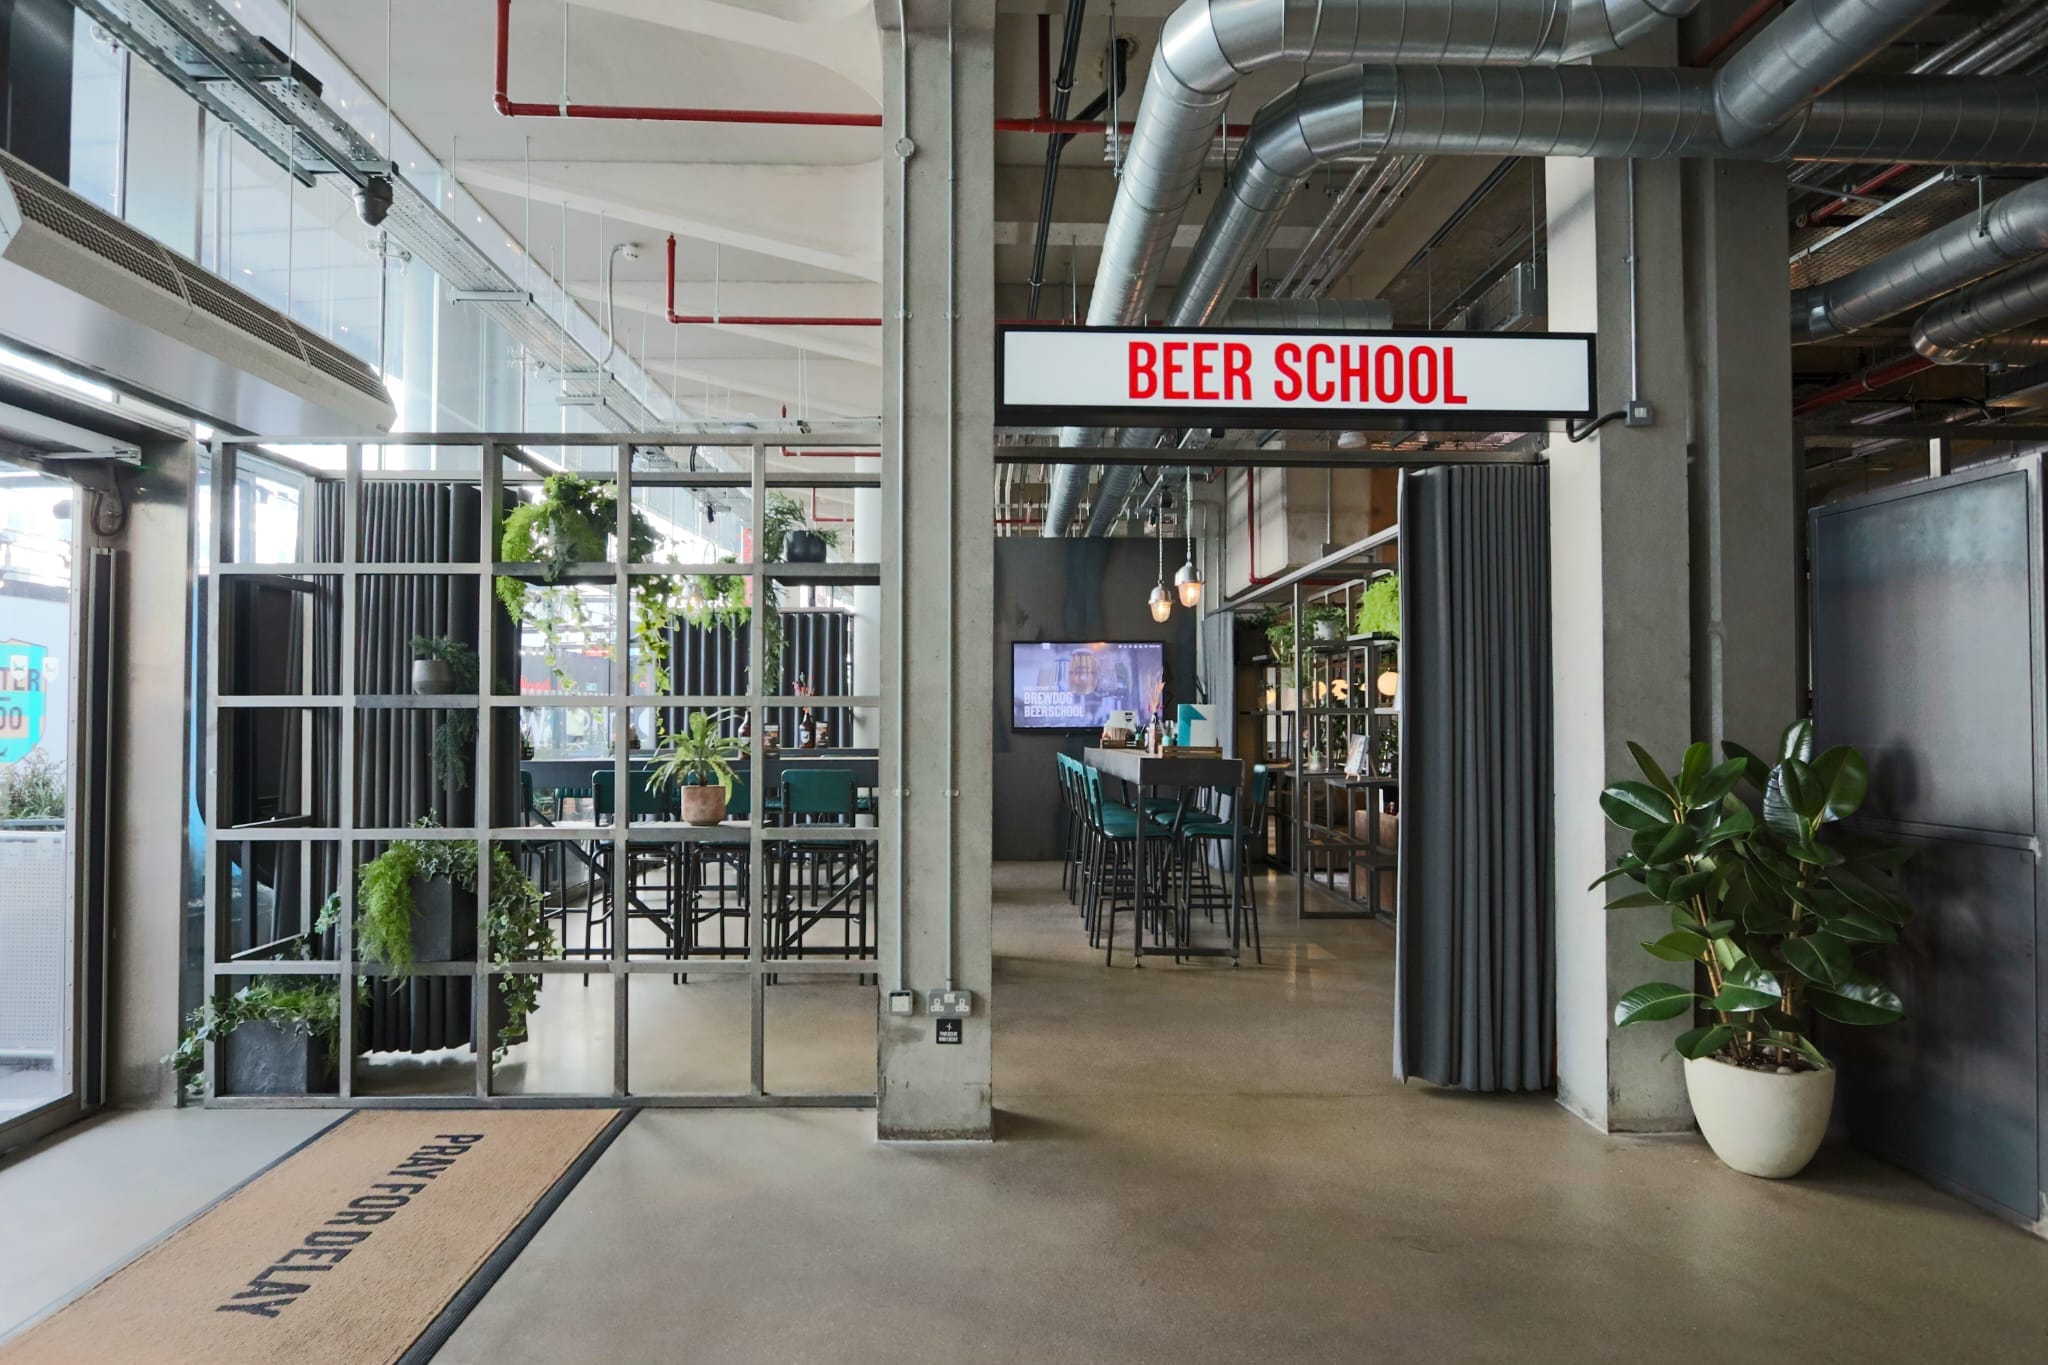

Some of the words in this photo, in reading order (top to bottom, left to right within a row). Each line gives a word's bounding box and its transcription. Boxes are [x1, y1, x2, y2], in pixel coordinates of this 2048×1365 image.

[1128, 341, 1252, 400] BEER
[1274, 342, 1468, 404] SCHOOL
[1023, 691, 1073, 705] BREWDOG
[1023, 705, 1048, 718] BEER
[1048, 705, 1085, 718] SCHOOL
[389, 1134, 485, 1179] PRAY
[323, 1183, 427, 1225] FOR
[215, 1231, 373, 1319] DELAY
